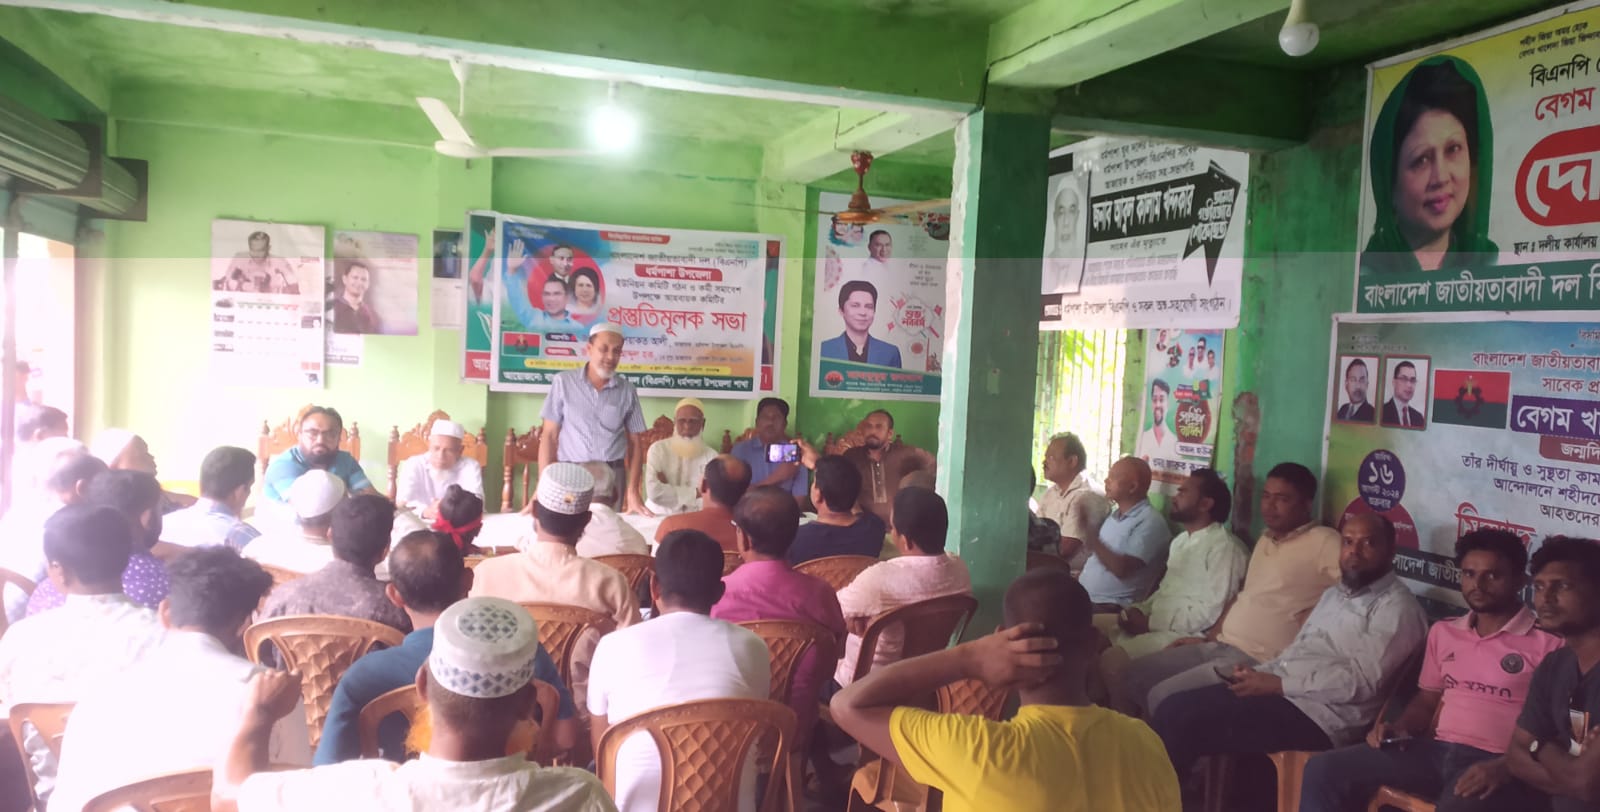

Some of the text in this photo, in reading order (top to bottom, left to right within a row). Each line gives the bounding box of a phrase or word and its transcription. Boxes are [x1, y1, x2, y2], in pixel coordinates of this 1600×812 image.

[1530, 54, 1591, 87] বিএনপি
[1535, 87, 1596, 121] বেগম
[1526, 158, 1600, 217] দো
[1092, 200, 1114, 232] জনাব
[1136, 190, 1163, 225] কালাম
[1539, 234, 1561, 251] দলীয়
[1564, 232, 1598, 250] কার্যালয়
[1364, 280, 1431, 308] বাংলাদেশ
[1435, 265, 1546, 305] জাতীয়তাবাদী
[1550, 273, 1583, 301] দল
[607, 302, 748, 336] প্রস্তুতিমূলক সভা
[1472, 348, 1600, 373] বাংলাদেশ জাতীয়তাবা
[1542, 377, 1585, 393] সাবেক
[1516, 405, 1575, 434] বেগম
[1560, 441, 1600, 461] জন্মদি
[1368, 461, 1395, 486] ১৬
[1461, 452, 1483, 469] তাঁর
[1486, 454, 1519, 478] দীর্ঘায়ু
[1523, 464, 1533, 476] ও
[1575, 470, 1600, 487] কাম
[1493, 477, 1600, 506] আন্দোলনে শহীদদে
[1540, 503, 1600, 527] আহতদের
[1393, 553, 1463, 585] লাদেশ জাতীয়
